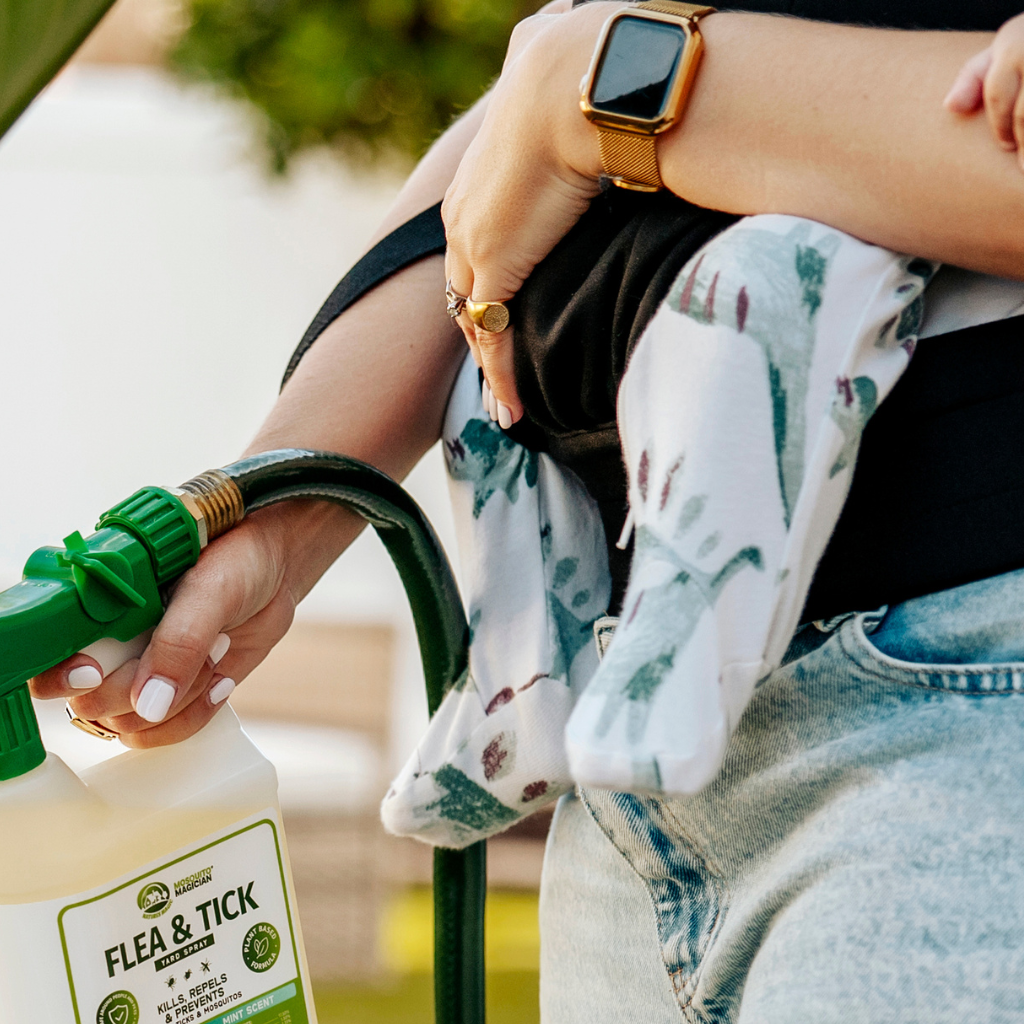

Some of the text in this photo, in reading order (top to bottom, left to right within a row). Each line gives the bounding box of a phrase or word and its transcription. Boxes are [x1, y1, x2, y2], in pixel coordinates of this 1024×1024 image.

[173, 866, 212, 890] MOSQUITO
[175, 874, 212, 897] MAGICIAN
[104, 880, 260, 978] FLEA & TICK
[244, 925, 277, 953] PLANT BASED
[161, 938, 208, 967] YARD SPRAY
[250, 952, 277, 970] FORMULA
[157, 973, 228, 1015] KILLS, REPELS
[165, 987, 225, 1024] & PREVENTS
[196, 1010, 202, 1018] &
[203, 991, 243, 1015] MOSQUITOS
[245, 995, 275, 1015] SCENT
